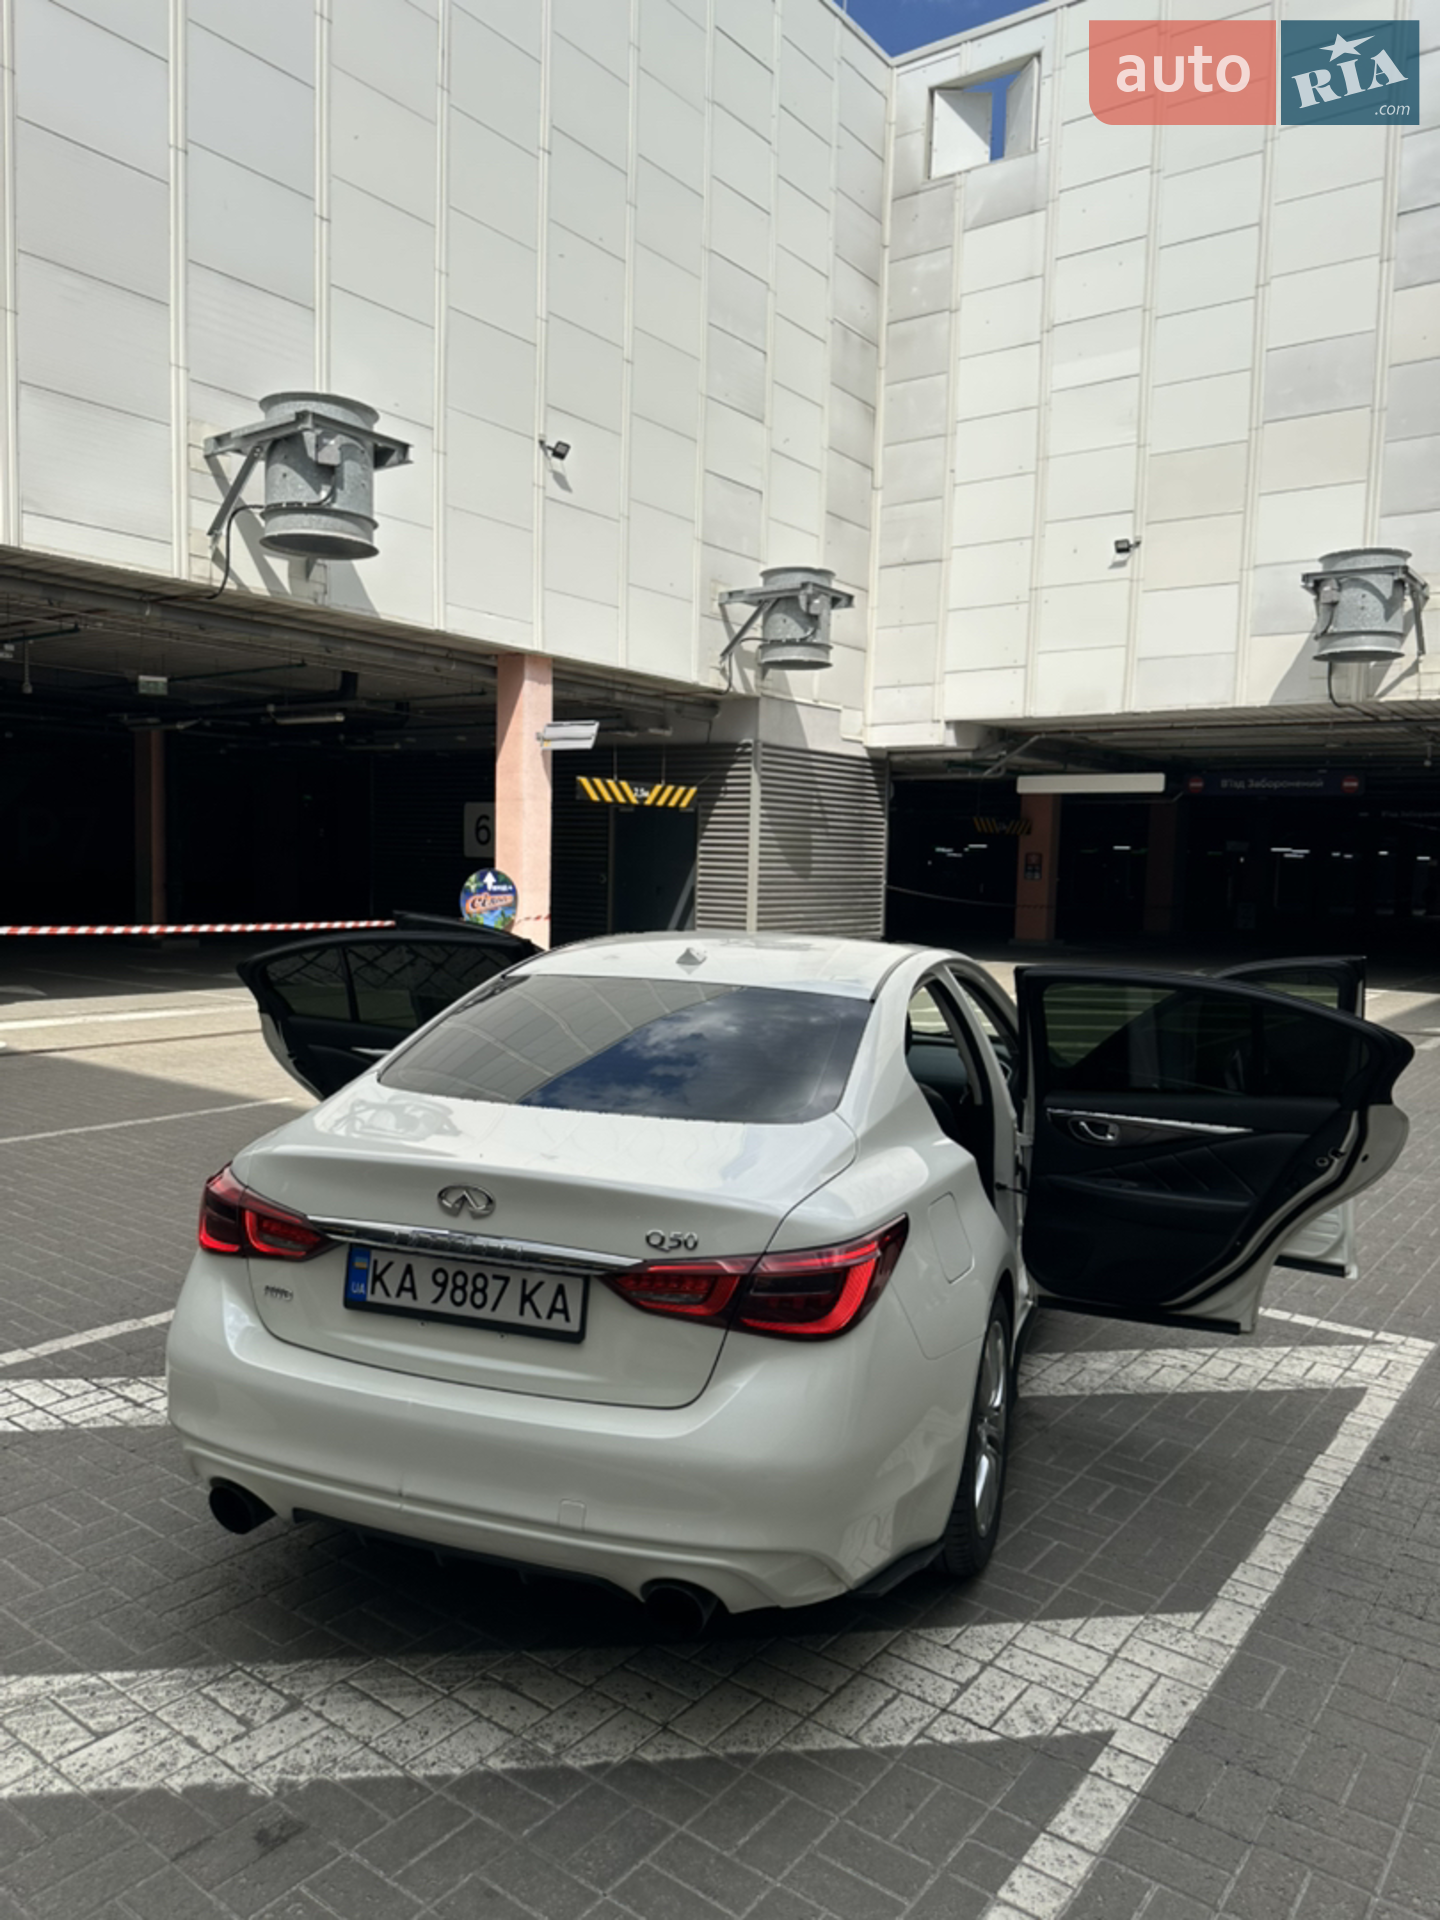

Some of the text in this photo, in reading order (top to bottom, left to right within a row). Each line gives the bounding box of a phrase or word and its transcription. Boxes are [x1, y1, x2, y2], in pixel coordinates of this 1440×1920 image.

[474, 815, 491, 845] 6
[645, 1229, 698, 1253] Q50
[351, 1283, 366, 1295] UA
[370, 1259, 571, 1323] KA 9887 KA
